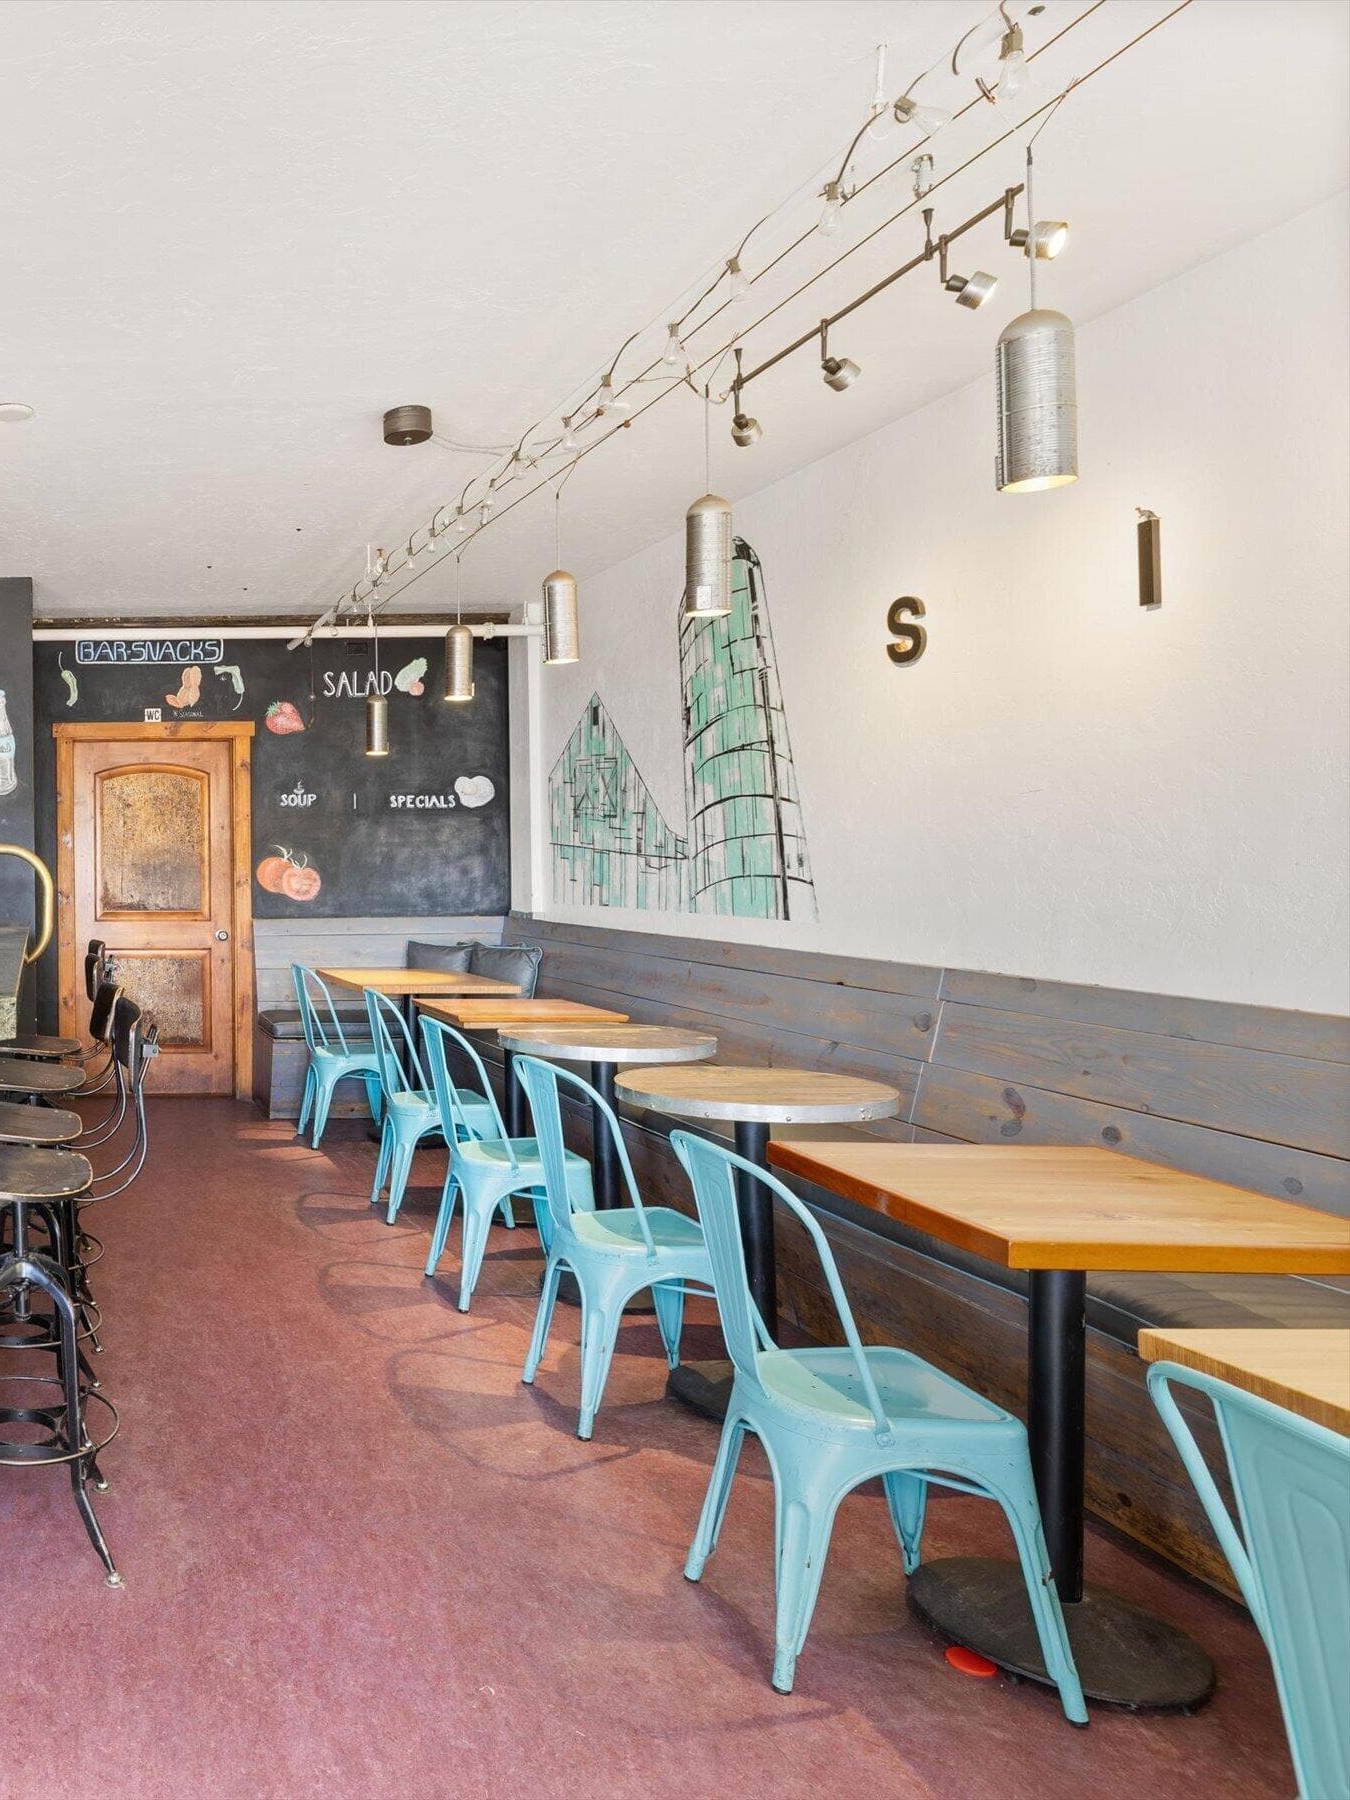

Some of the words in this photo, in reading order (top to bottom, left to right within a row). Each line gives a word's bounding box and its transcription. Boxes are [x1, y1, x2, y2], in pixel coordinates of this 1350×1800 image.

[886, 596, 927, 667] S
[80, 640, 221, 662] BAR-SNACKS
[323, 670, 393, 698] SALAD
[146, 710, 160, 721] WC
[280, 793, 317, 807] SOUP
[390, 795, 456, 808] SPECIALS
